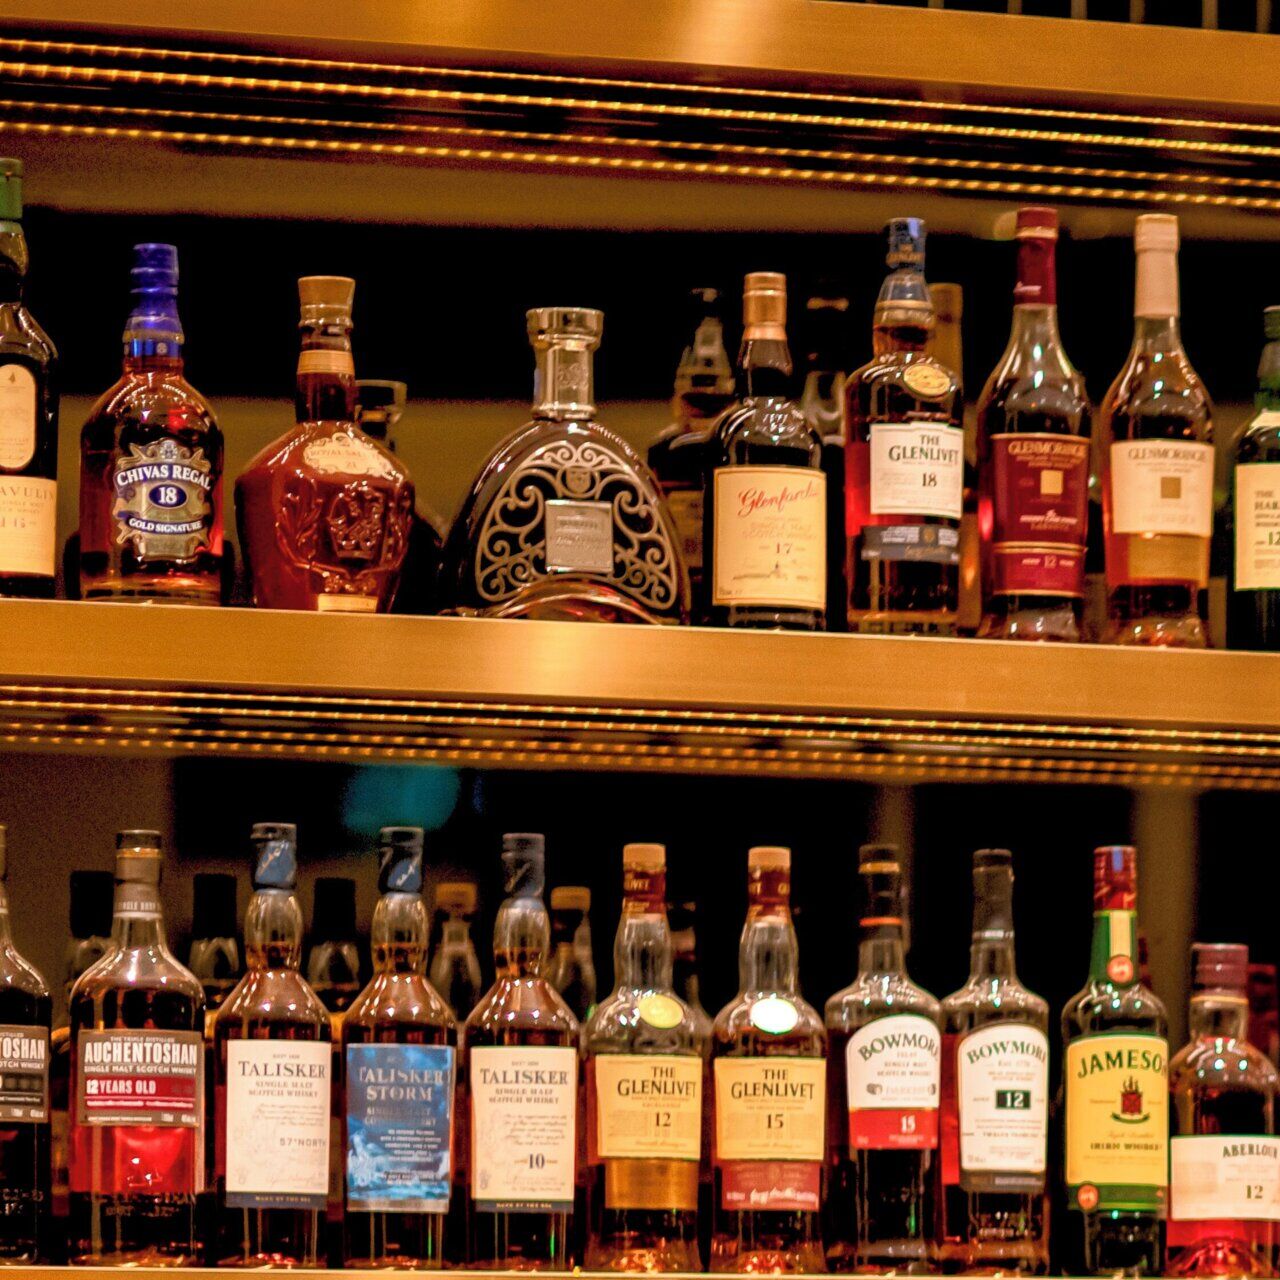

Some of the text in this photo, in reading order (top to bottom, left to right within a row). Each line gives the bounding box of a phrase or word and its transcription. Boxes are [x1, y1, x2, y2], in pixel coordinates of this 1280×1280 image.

[920, 434, 940, 445] THE
[888, 445, 959, 465] GLENLIVET
[117, 465, 211, 490] CHIVAS REGAL
[922, 472, 937, 487] 18
[158, 487, 177, 504] 18
[129, 518, 201, 532] GOLD SIGNATURE
[776, 542, 793, 555] 17
[84, 1041, 198, 1066] AUCHENTOSHAN
[112, 1065, 133, 1073] MALT
[136, 1065, 169, 1073] SCOTCH
[238, 1061, 326, 1079] TALISKER
[359, 1068, 444, 1085] TALISKER
[480, 1068, 569, 1085] TALISKER
[651, 1066, 676, 1078] THE
[763, 1069, 788, 1080] THE
[86, 1079, 156, 1094] 12 YEARS OLD
[366, 1085, 433, 1103] STORM
[617, 1078, 697, 1098] GLENLIVET
[731, 1082, 815, 1100] GLENLIVET
[1005, 1091, 1024, 1108] 12
[655, 1111, 672, 1127] 12
[766, 1113, 784, 1129] 15
[901, 1115, 916, 1134] 15
[528, 1152, 546, 1170] 10
[1246, 1185, 1263, 1199] 12
